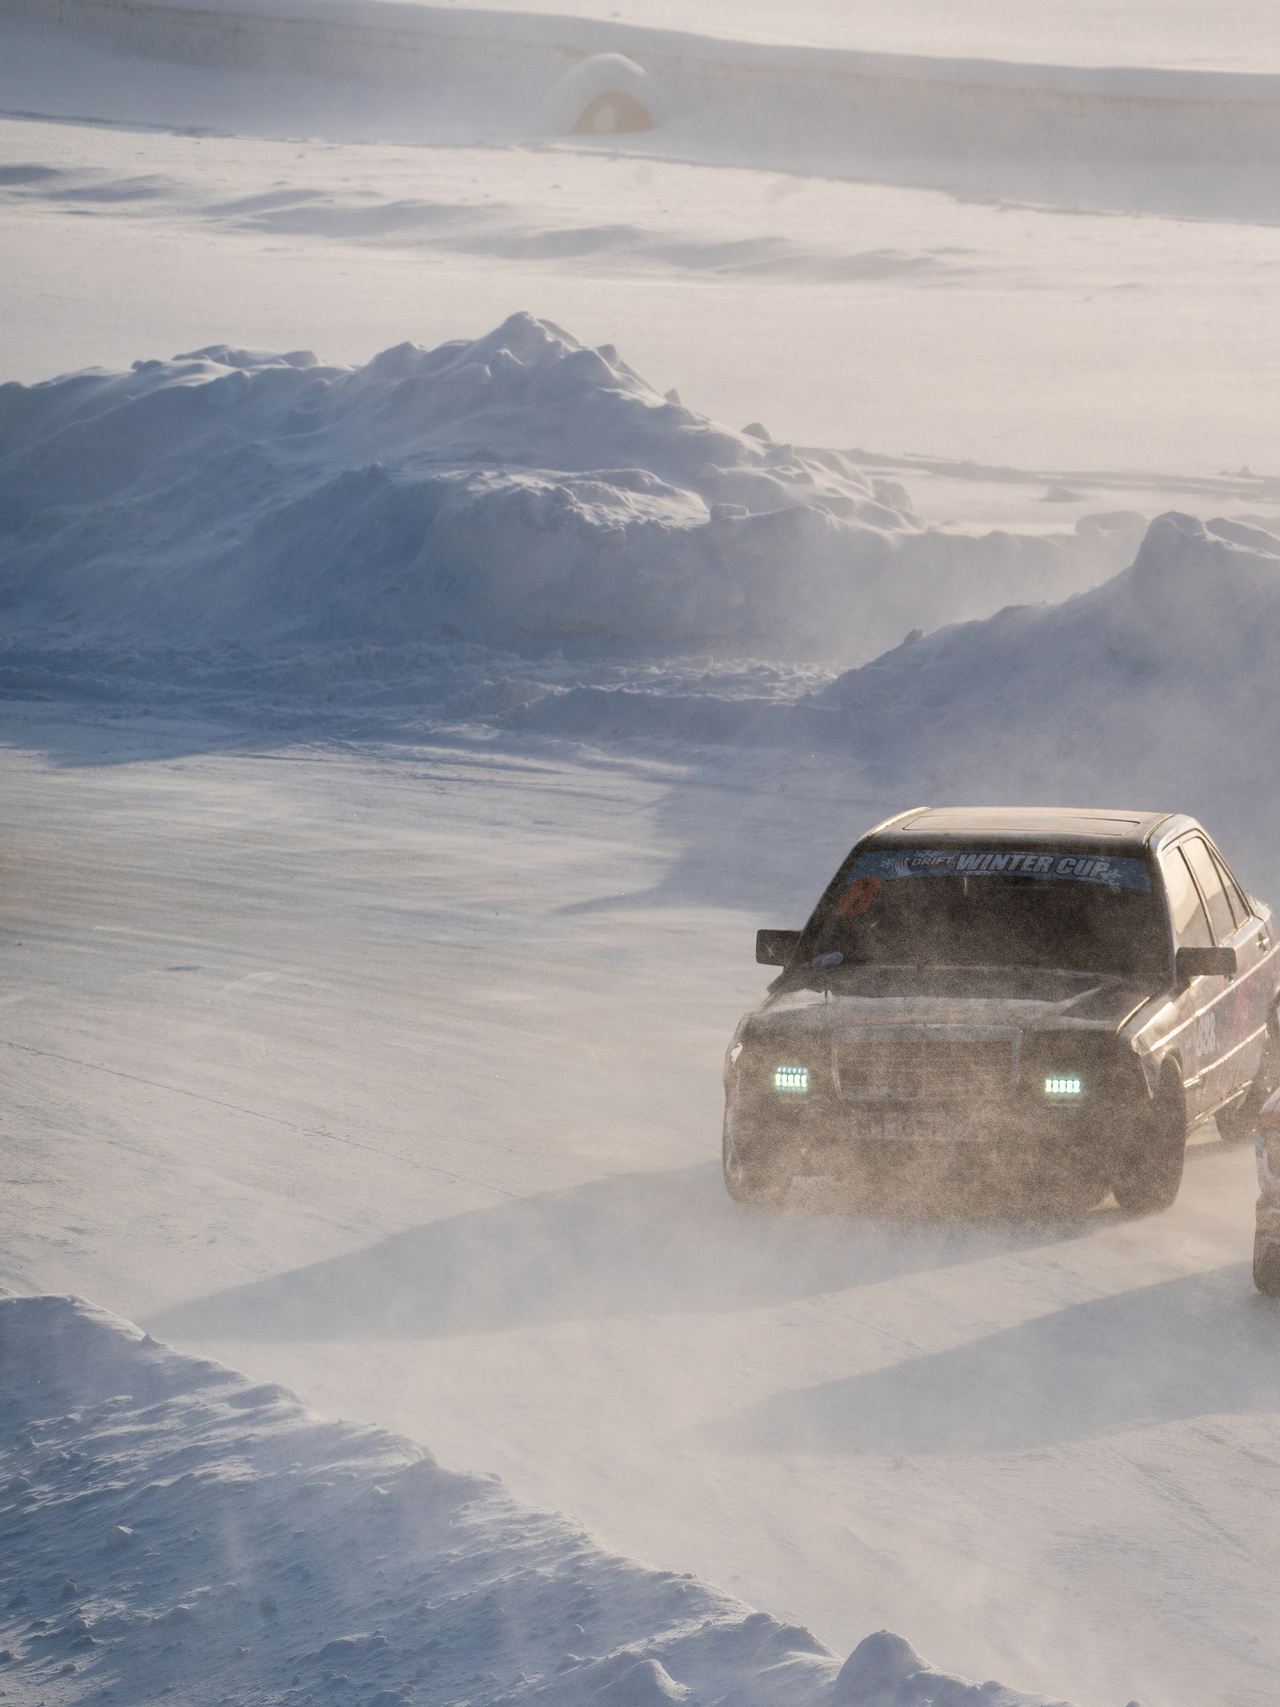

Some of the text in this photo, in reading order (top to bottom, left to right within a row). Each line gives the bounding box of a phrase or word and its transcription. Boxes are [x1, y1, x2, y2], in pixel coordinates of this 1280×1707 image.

[911, 853, 1111, 878] DRIFT WINTER CUP
